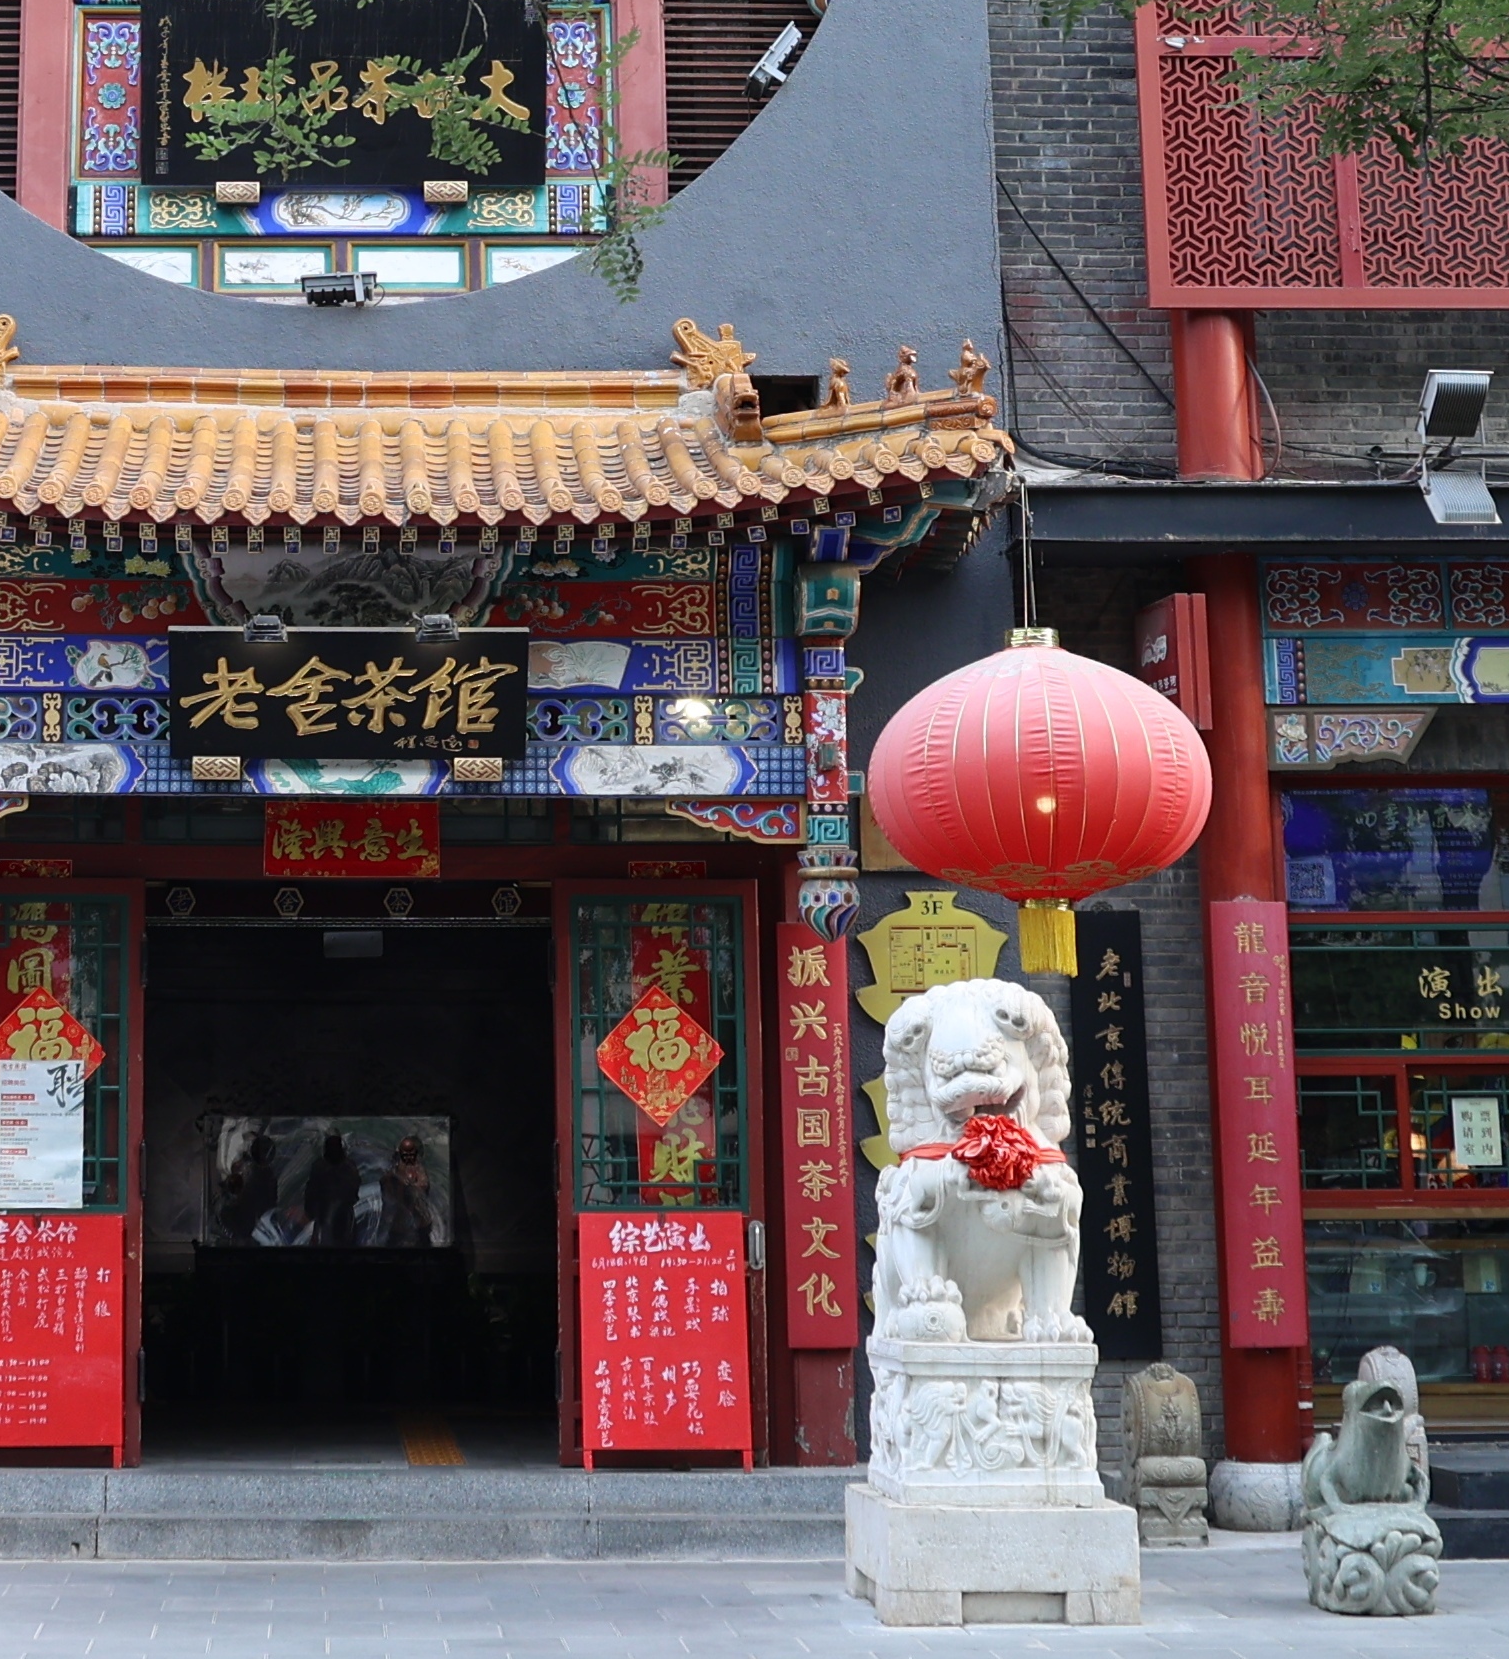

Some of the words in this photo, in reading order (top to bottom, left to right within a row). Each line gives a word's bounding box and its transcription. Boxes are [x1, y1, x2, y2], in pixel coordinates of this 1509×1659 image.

[179, 655, 519, 736] 老舍茶馆
[921, 900, 943, 916] 3F
[1438, 1002, 1501, 1020] Show
[625, 1007, 691, 1072] 福
[786, 944, 843, 1319] 振兴古国茶文化
[1460, 1110, 1491, 1123] 购票
[1462, 1127, 1493, 1139] 请到
[609, 1220, 711, 1254] 综艺演出
[33, 1266, 50, 1329] 武松打虎
[52, 1268, 69, 1336] 三打白骨精
